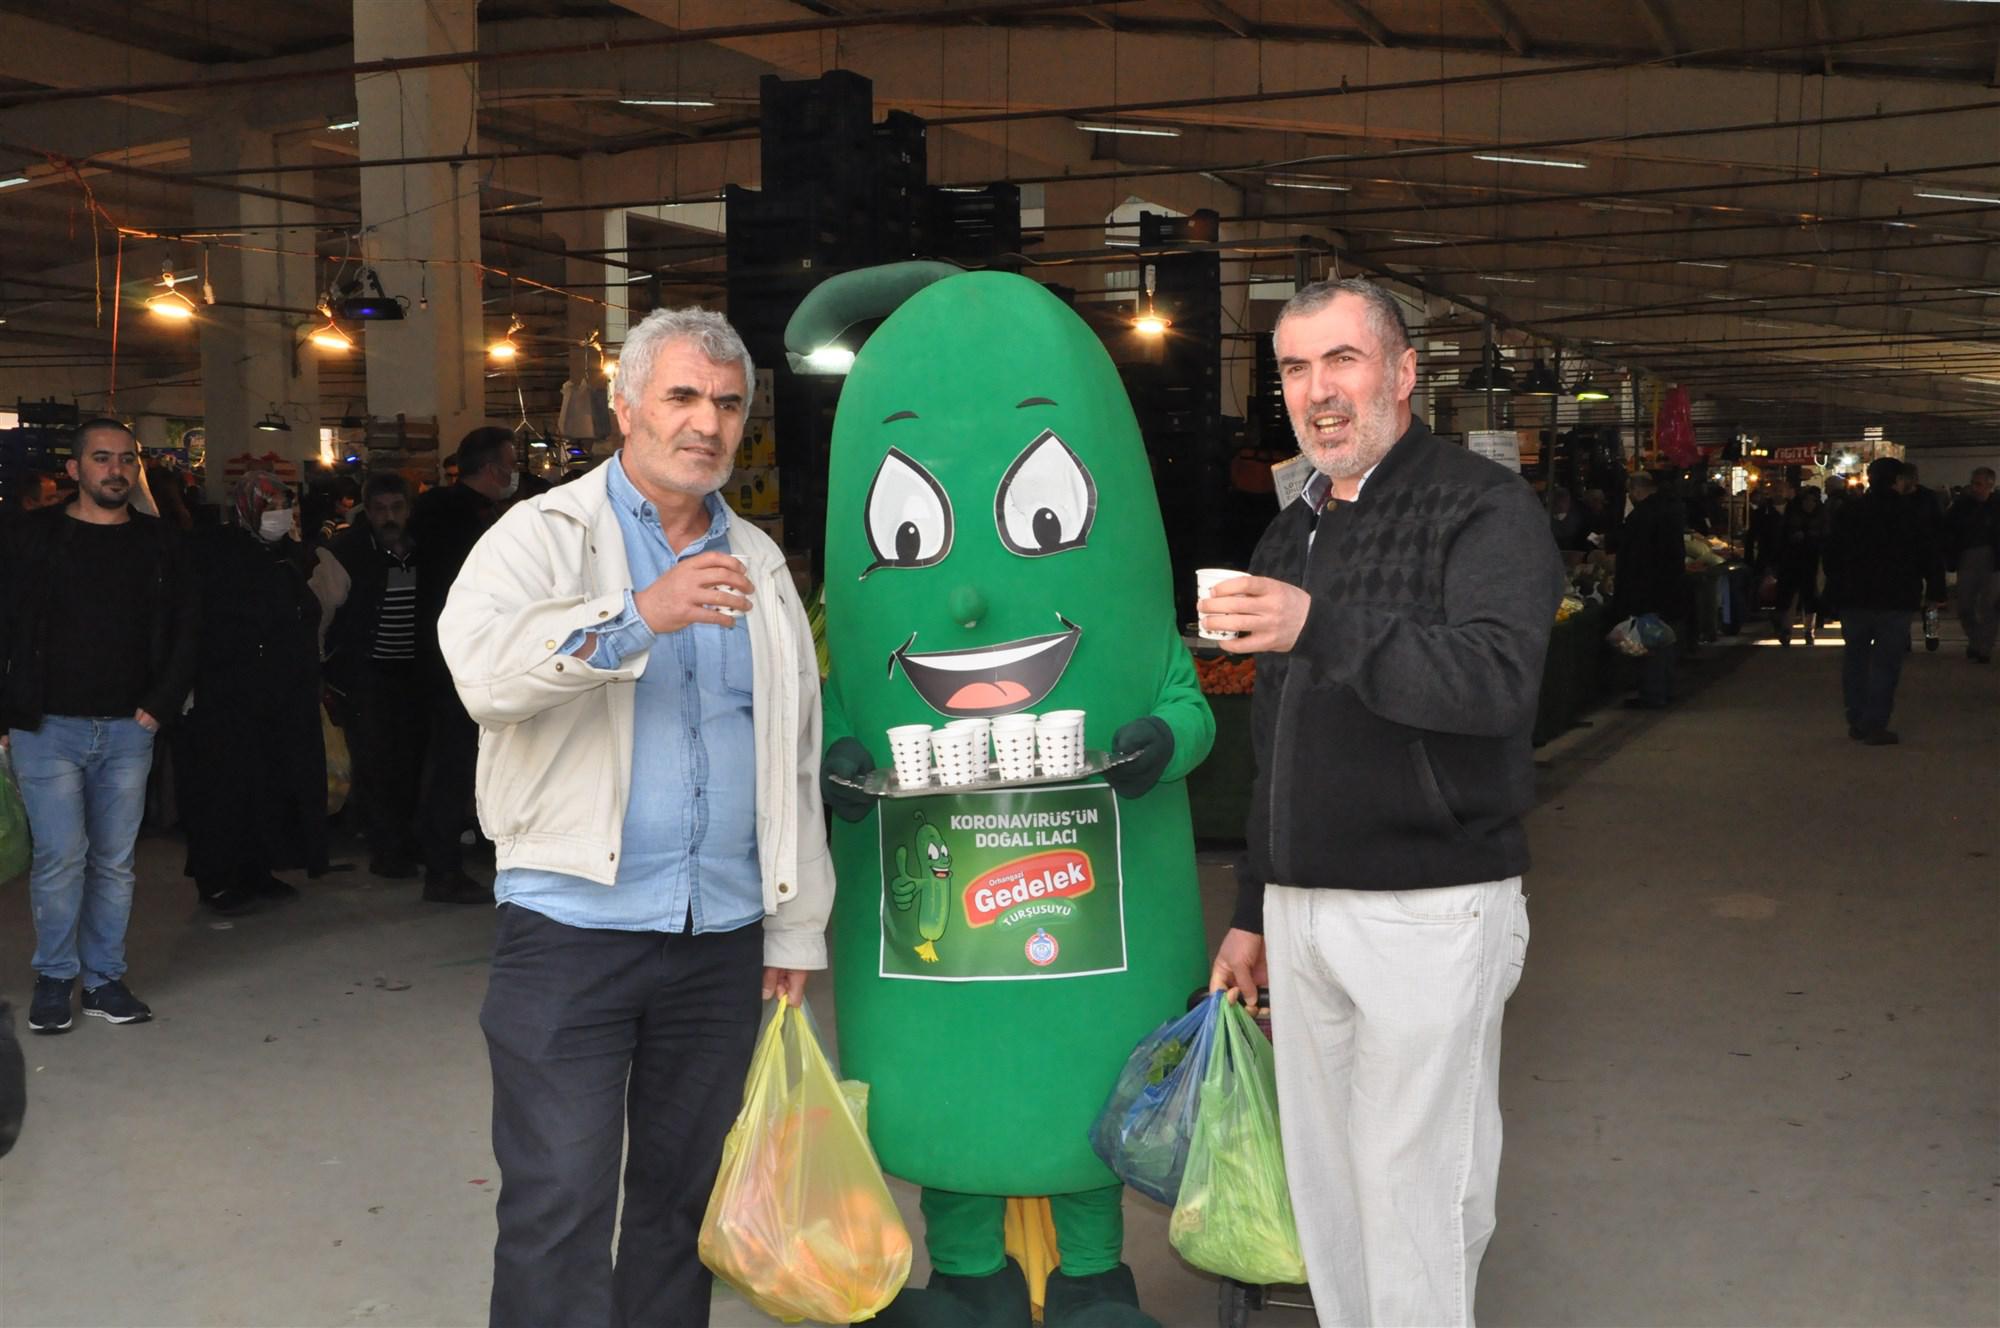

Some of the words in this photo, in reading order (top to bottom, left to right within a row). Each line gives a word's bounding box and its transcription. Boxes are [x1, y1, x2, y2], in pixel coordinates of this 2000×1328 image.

[976, 831, 1033, 848] DOĞAL
[975, 863, 1086, 912] Gedelek
[1003, 904, 1071, 926] TURŞUSUYU
